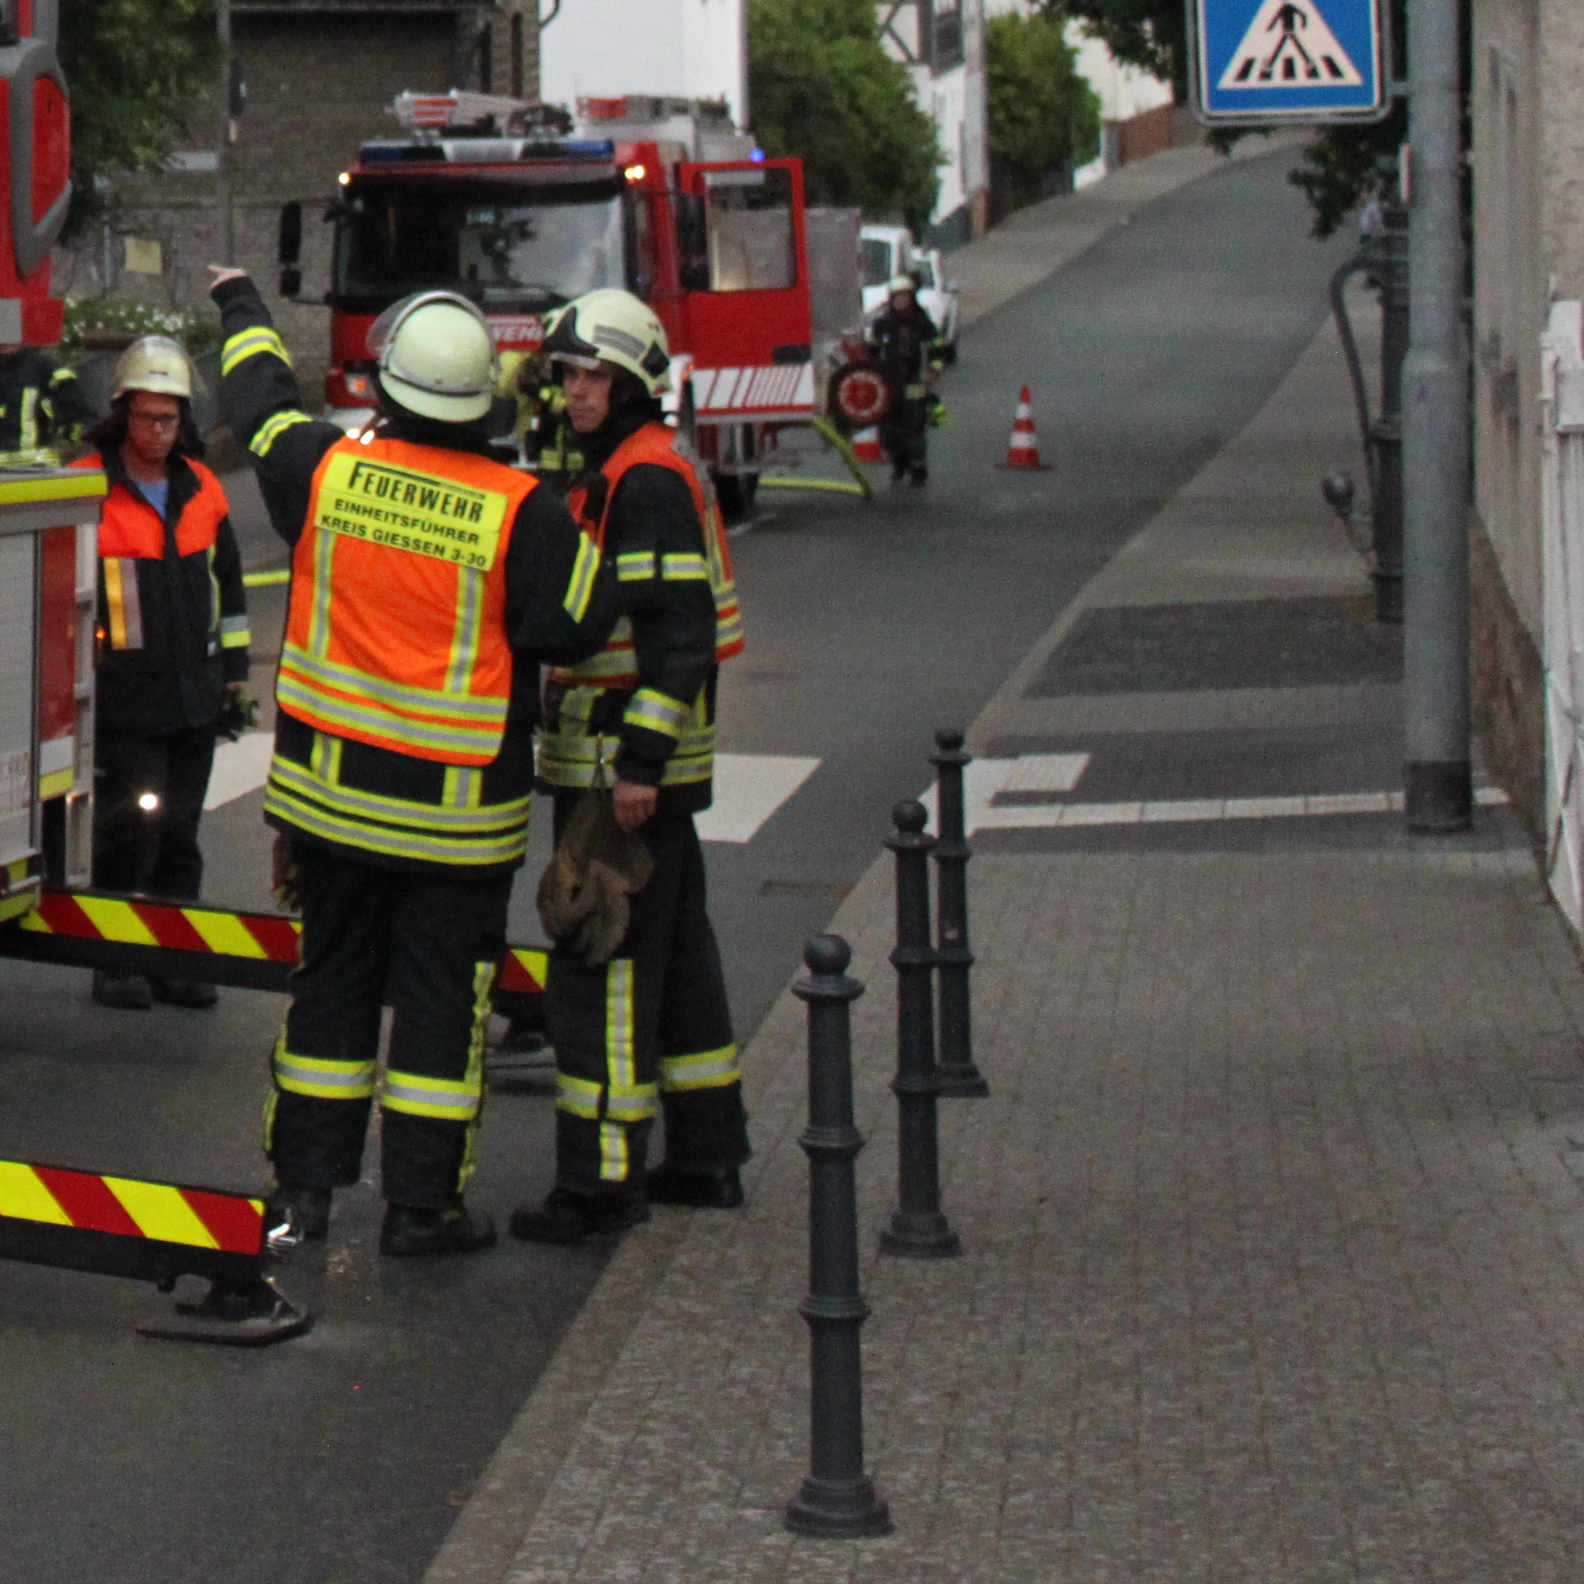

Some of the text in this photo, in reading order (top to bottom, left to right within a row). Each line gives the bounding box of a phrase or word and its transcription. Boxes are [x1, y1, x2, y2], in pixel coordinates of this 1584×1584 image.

[348, 461, 485, 524] FEUERWEHR
[321, 514, 487, 568] KREIS GIESSEN 3-30
